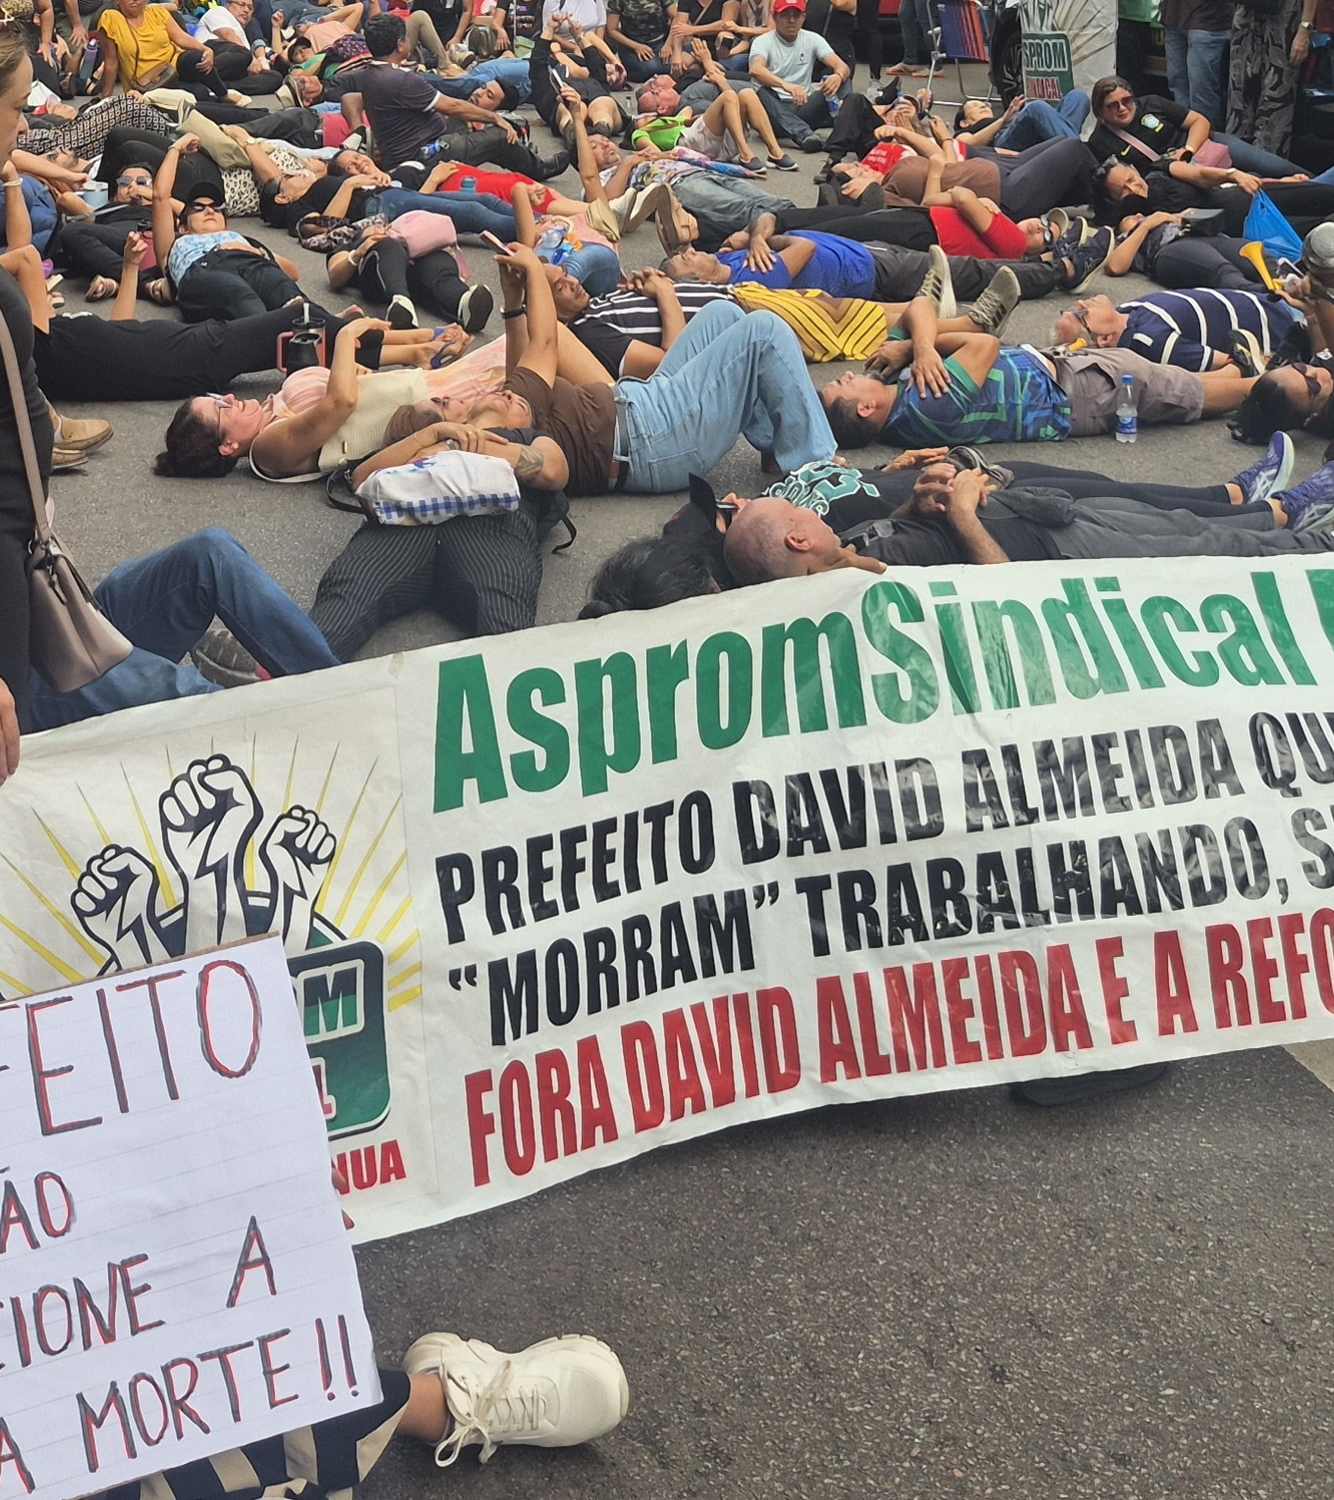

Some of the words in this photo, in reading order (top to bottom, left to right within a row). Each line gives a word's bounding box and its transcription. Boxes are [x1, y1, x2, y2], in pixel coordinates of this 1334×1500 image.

[433, 569, 1319, 814] AspromSindical
[434, 788, 716, 945] PREFEITO
[734, 754, 944, 867] DAVID
[960, 717, 1244, 834] ALMEIDA
[795, 815, 1289, 958] TRABALHANDO,
[464, 1036, 620, 1187] FORA
[620, 986, 802, 1129] DAVID
[814, 941, 1094, 1084] ALMEIDA
[1094, 934, 1137, 1046] E
[1153, 928, 1199, 1036] A
[226, 1216, 277, 1308] A
